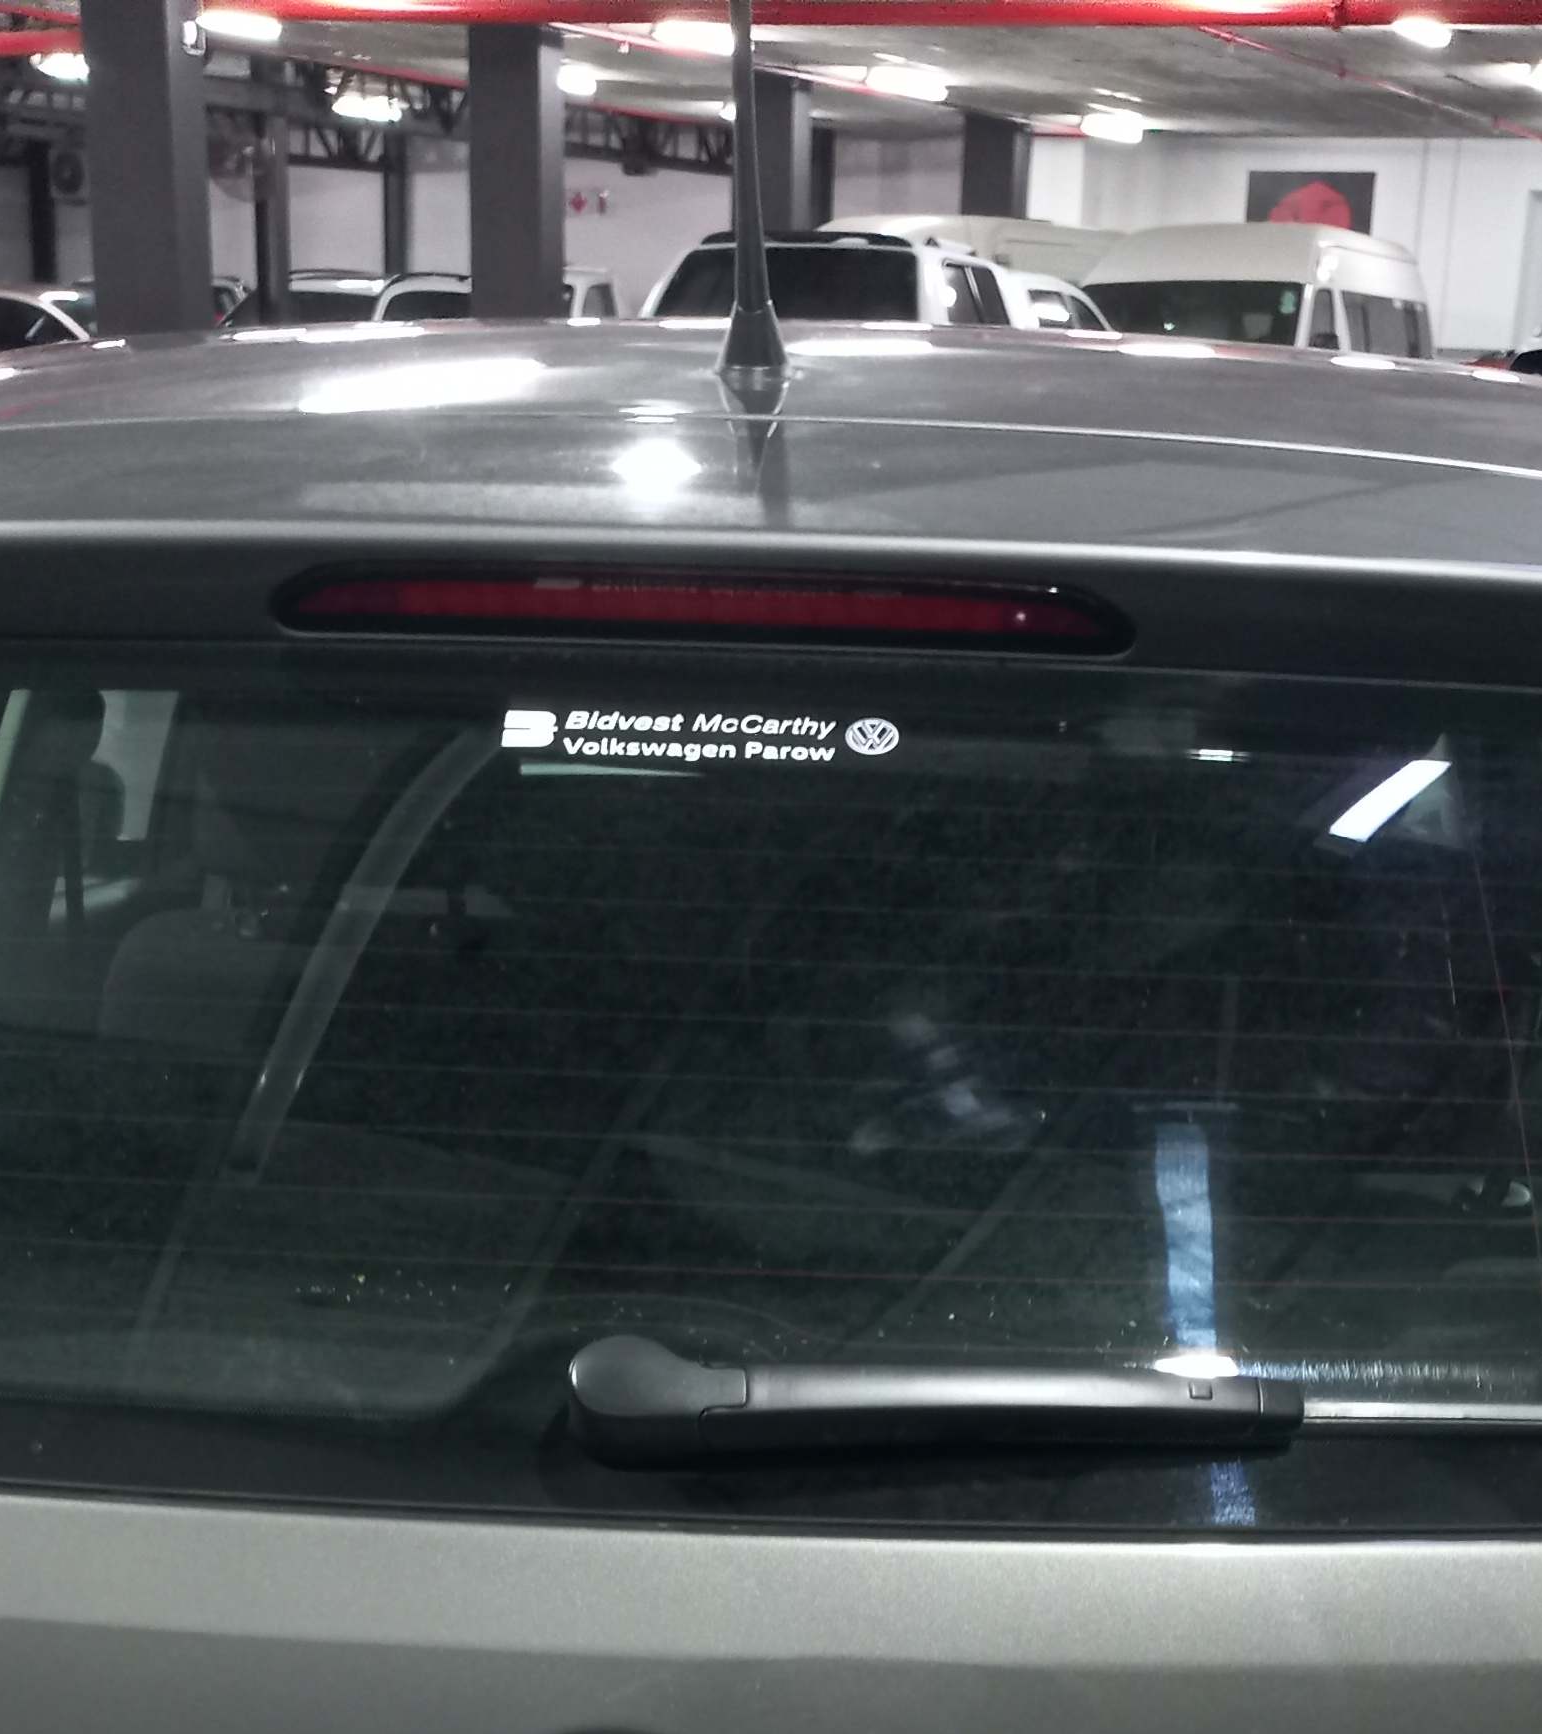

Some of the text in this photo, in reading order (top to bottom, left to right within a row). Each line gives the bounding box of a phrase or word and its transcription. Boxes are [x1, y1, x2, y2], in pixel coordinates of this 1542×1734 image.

[564, 710, 837, 741] Bidvest McCarthy
[562, 736, 836, 763] Volkswagen Parow
